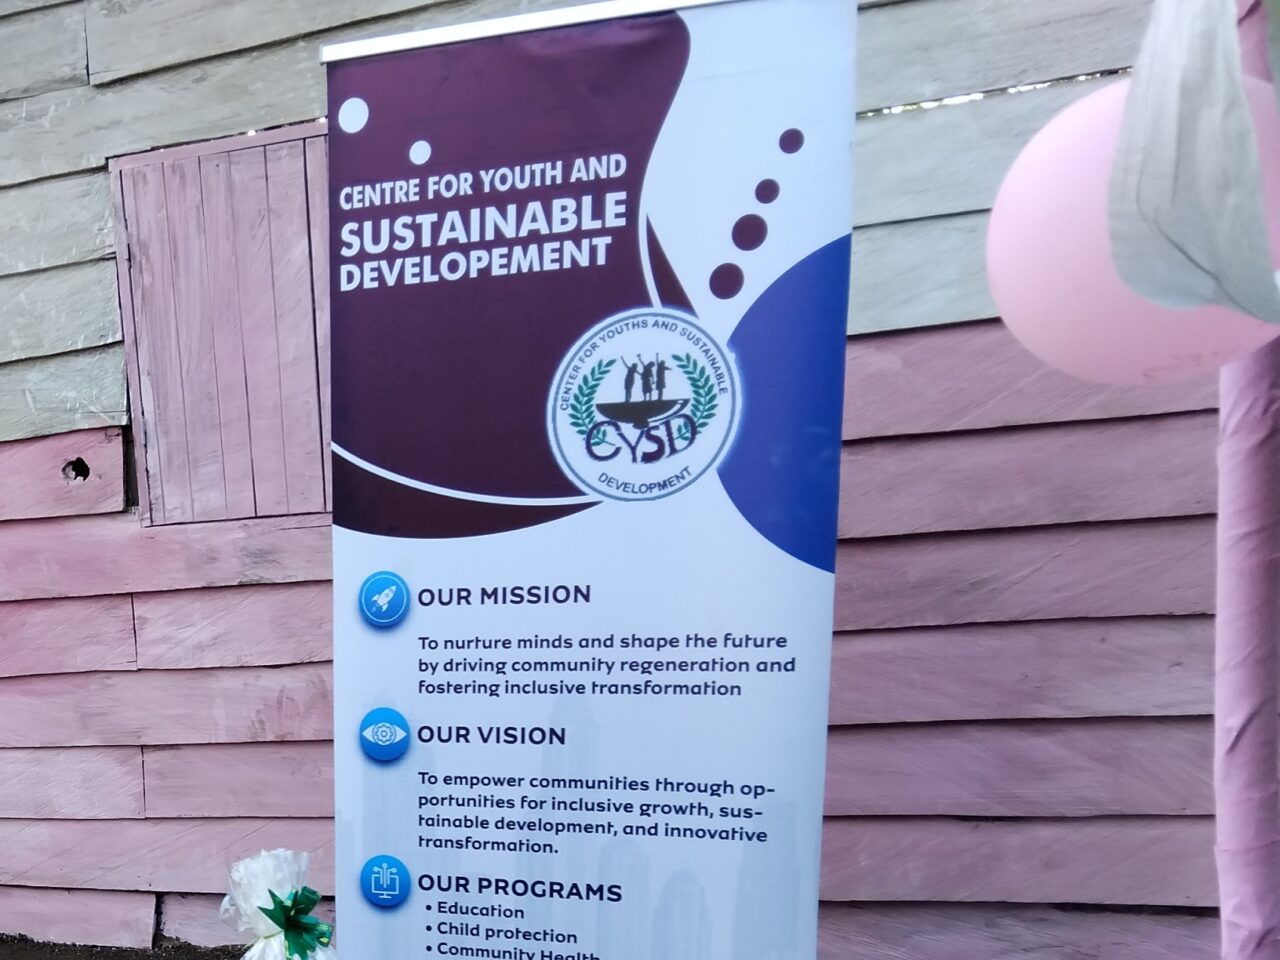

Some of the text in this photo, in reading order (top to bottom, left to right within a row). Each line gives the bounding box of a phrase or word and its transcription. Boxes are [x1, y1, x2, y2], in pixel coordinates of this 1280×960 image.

[340, 153, 627, 211] CENTRE FOR YOUTH AND
[340, 191, 627, 258] SUSTAINABLE
[340, 236, 612, 292] DEVELOPEMENT
[559, 319, 728, 412] CENTER FOR YOUTHS AND SUSTAINABLE
[585, 413, 699, 465] CYSD
[597, 465, 693, 495] DEVELOPMENT
[418, 585, 590, 606] OUR MISSION
[418, 633, 787, 653] To nurture minds and shape the future
[419, 657, 795, 675] by driving community regeneration and
[419, 680, 741, 697] fostering inclusive transformation
[418, 726, 565, 745] OUR VISION
[418, 772, 775, 799] To empower communities through op-
[419, 794, 763, 819] portunities for inclusive growth, sus-
[419, 814, 767, 842] tainable development, and innovative
[419, 835, 558, 853] transformation.
[418, 874, 622, 902] OUR PROGRAMS
[438, 901, 524, 919] Education
[437, 922, 577, 943] Child protection
